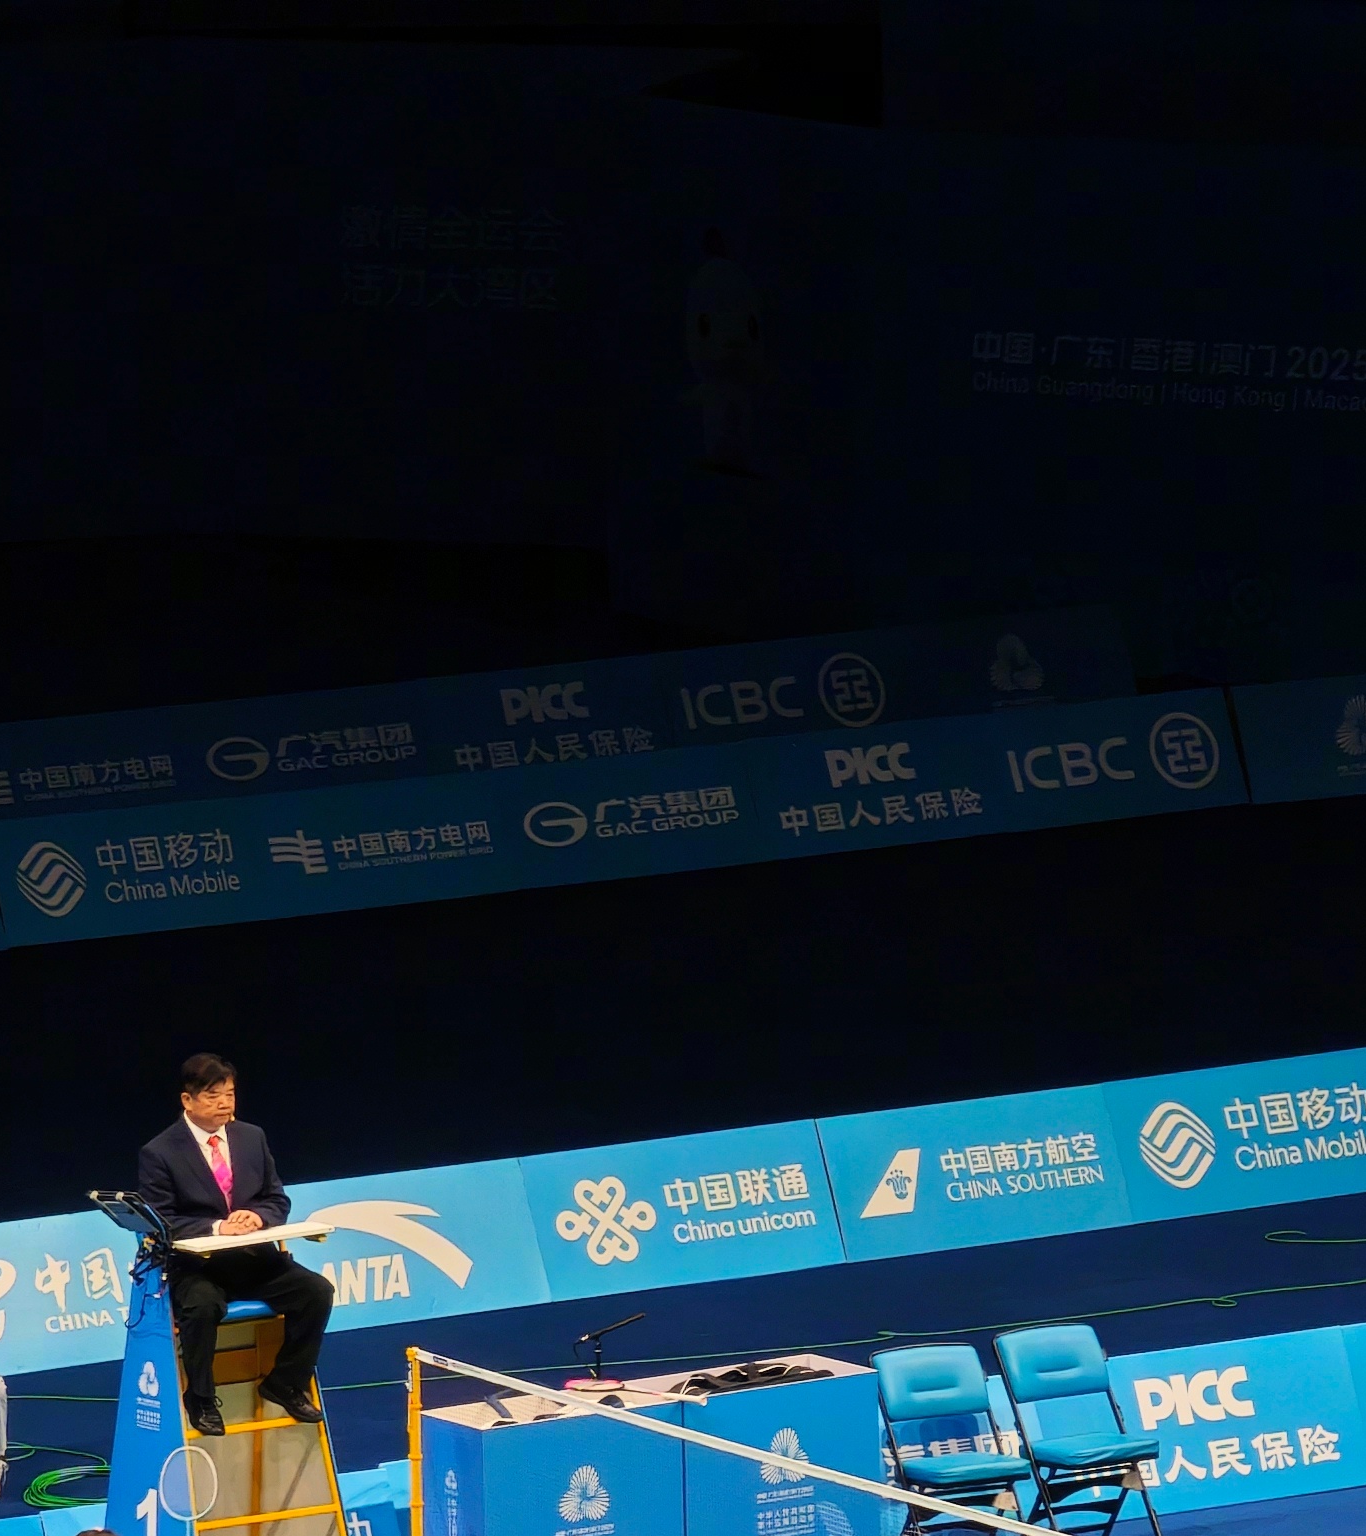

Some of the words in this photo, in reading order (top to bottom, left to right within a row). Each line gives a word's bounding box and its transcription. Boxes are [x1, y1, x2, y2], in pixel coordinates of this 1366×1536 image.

[972, 372, 1029, 393] China
[1037, 375, 1153, 403] Guangdong
[1173, 384, 1225, 409] Hong
[1234, 386, 1284, 411] Kong
[500, 681, 589, 725] PICC
[680, 676, 804, 730] ICBC
[276, 722, 412, 758] 广汽集团
[278, 755, 327, 772] GAC
[332, 744, 417, 767] GROUP
[454, 726, 655, 771] 中国人民保险
[19, 754, 174, 791] 中国南方电网
[825, 743, 916, 788] PICC
[1007, 737, 1136, 793] ICBC
[595, 786, 734, 822] 广汽集团
[596, 820, 647, 837] GAC
[651, 809, 740, 833] GROUP
[778, 786, 983, 837] 中国人民保险
[96, 828, 233, 875] 中国移动
[334, 821, 491, 860] 中国南方电网
[105, 879, 166, 904] China
[170, 871, 241, 897] Mobile
[940, 1132, 1100, 1177] 中国南方航空
[1235, 1143, 1299, 1171] China
[663, 1164, 809, 1215] 中国联通
[947, 1179, 1003, 1203] CHINA
[1008, 1166, 1104, 1196] SOUTHERN
[673, 1220, 734, 1244] China
[739, 1209, 816, 1235] unicom
[321, 1254, 411, 1306] ANTA
[45, 1310, 116, 1334] CHINA
[1133, 1366, 1255, 1431] PICC
